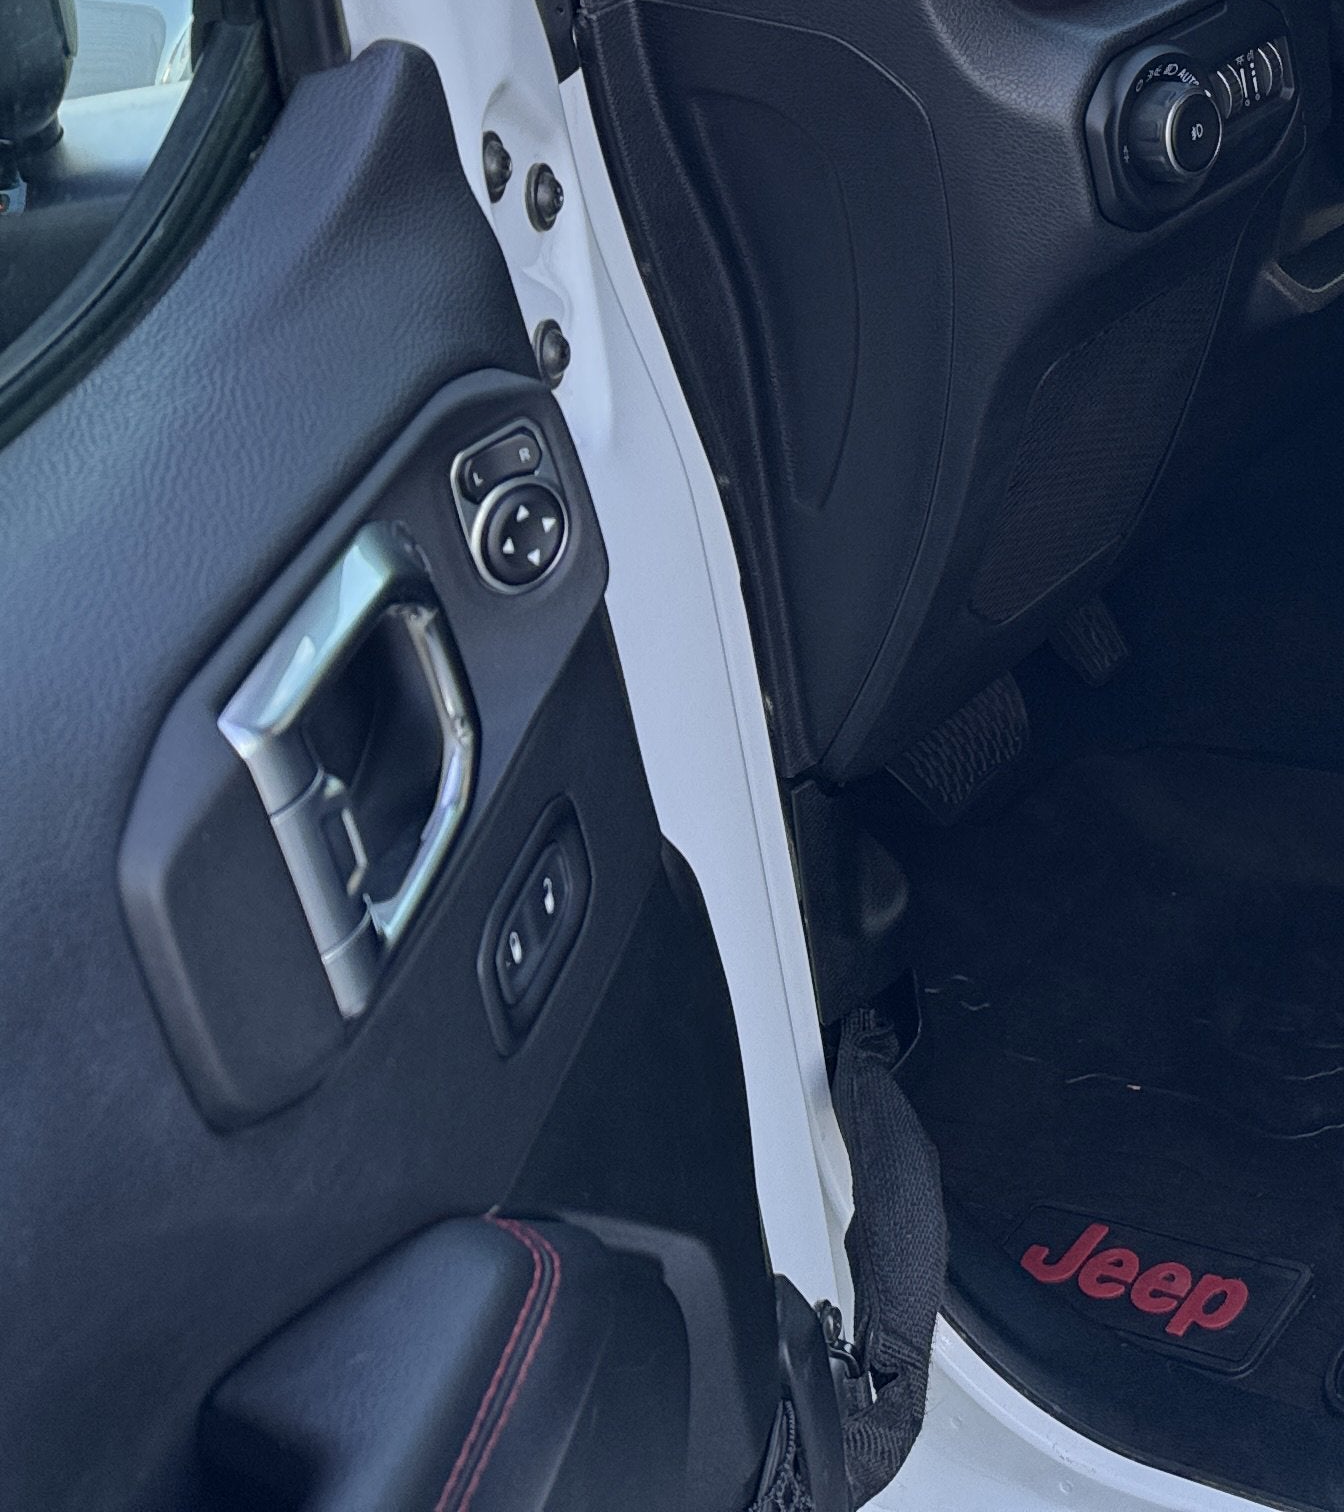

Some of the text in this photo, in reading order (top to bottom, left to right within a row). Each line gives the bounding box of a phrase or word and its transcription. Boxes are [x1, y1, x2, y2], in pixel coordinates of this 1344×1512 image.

[518, 447, 531, 463] R
[472, 472, 484, 487] L
[1019, 1222, 1249, 1336] Jeep
